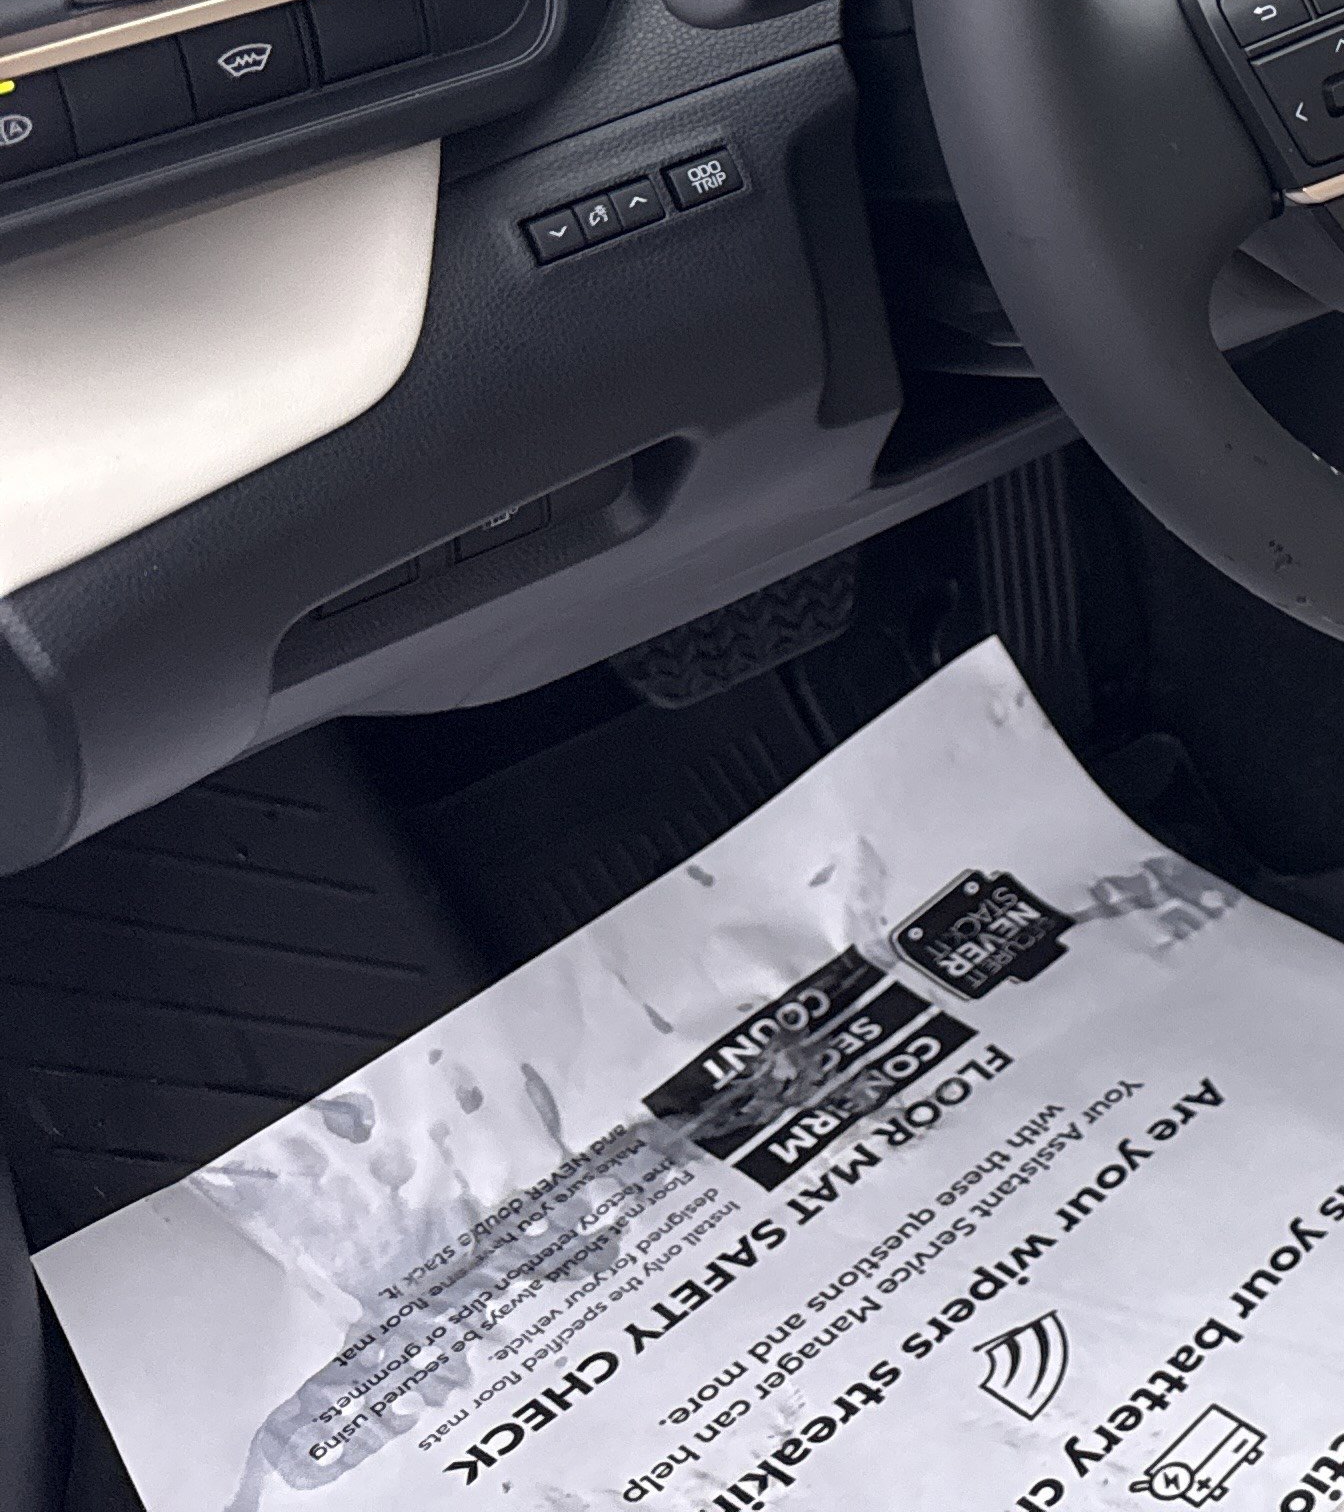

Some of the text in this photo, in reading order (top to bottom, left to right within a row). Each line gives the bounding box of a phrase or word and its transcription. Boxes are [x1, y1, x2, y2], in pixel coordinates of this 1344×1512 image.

[687, 160, 722, 182] ODO
[692, 171, 726, 194] TRIP
[936, 899, 1041, 981] NEVER
[701, 984, 834, 1091] COUNT
[593, 1136, 647, 1177] Make
[1146, 1078, 1224, 1141] Are
[377, 1123, 628, 1304] and NEVER double stack it.
[516, 1201, 554, 1235] you
[553, 1171, 595, 1206] sure
[1055, 1138, 1154, 1232] your
[311, 1156, 676, 1427] the factory retention clips or grommets.
[442, 1041, 1016, 1485] FLOOR MAT SAFETY CHECK
[488, 1188, 719, 1360] designed for your vehicle.
[623, 1080, 1143, 1502] Your Assistant Service Manager can help
[659, 1105, 1065, 1426] with these questions and more.
[902, 1234, 1058, 1359] wipers
[1230, 1217, 1327, 1319] your
[306, 1167, 696, 1464] Floor mat should always be secured using
[331, 1332, 377, 1369] mat
[375, 1295, 429, 1336] floor
[418, 1201, 741, 1451] Install only the specified floor mats
[1064, 1318, 1243, 1478] battery
